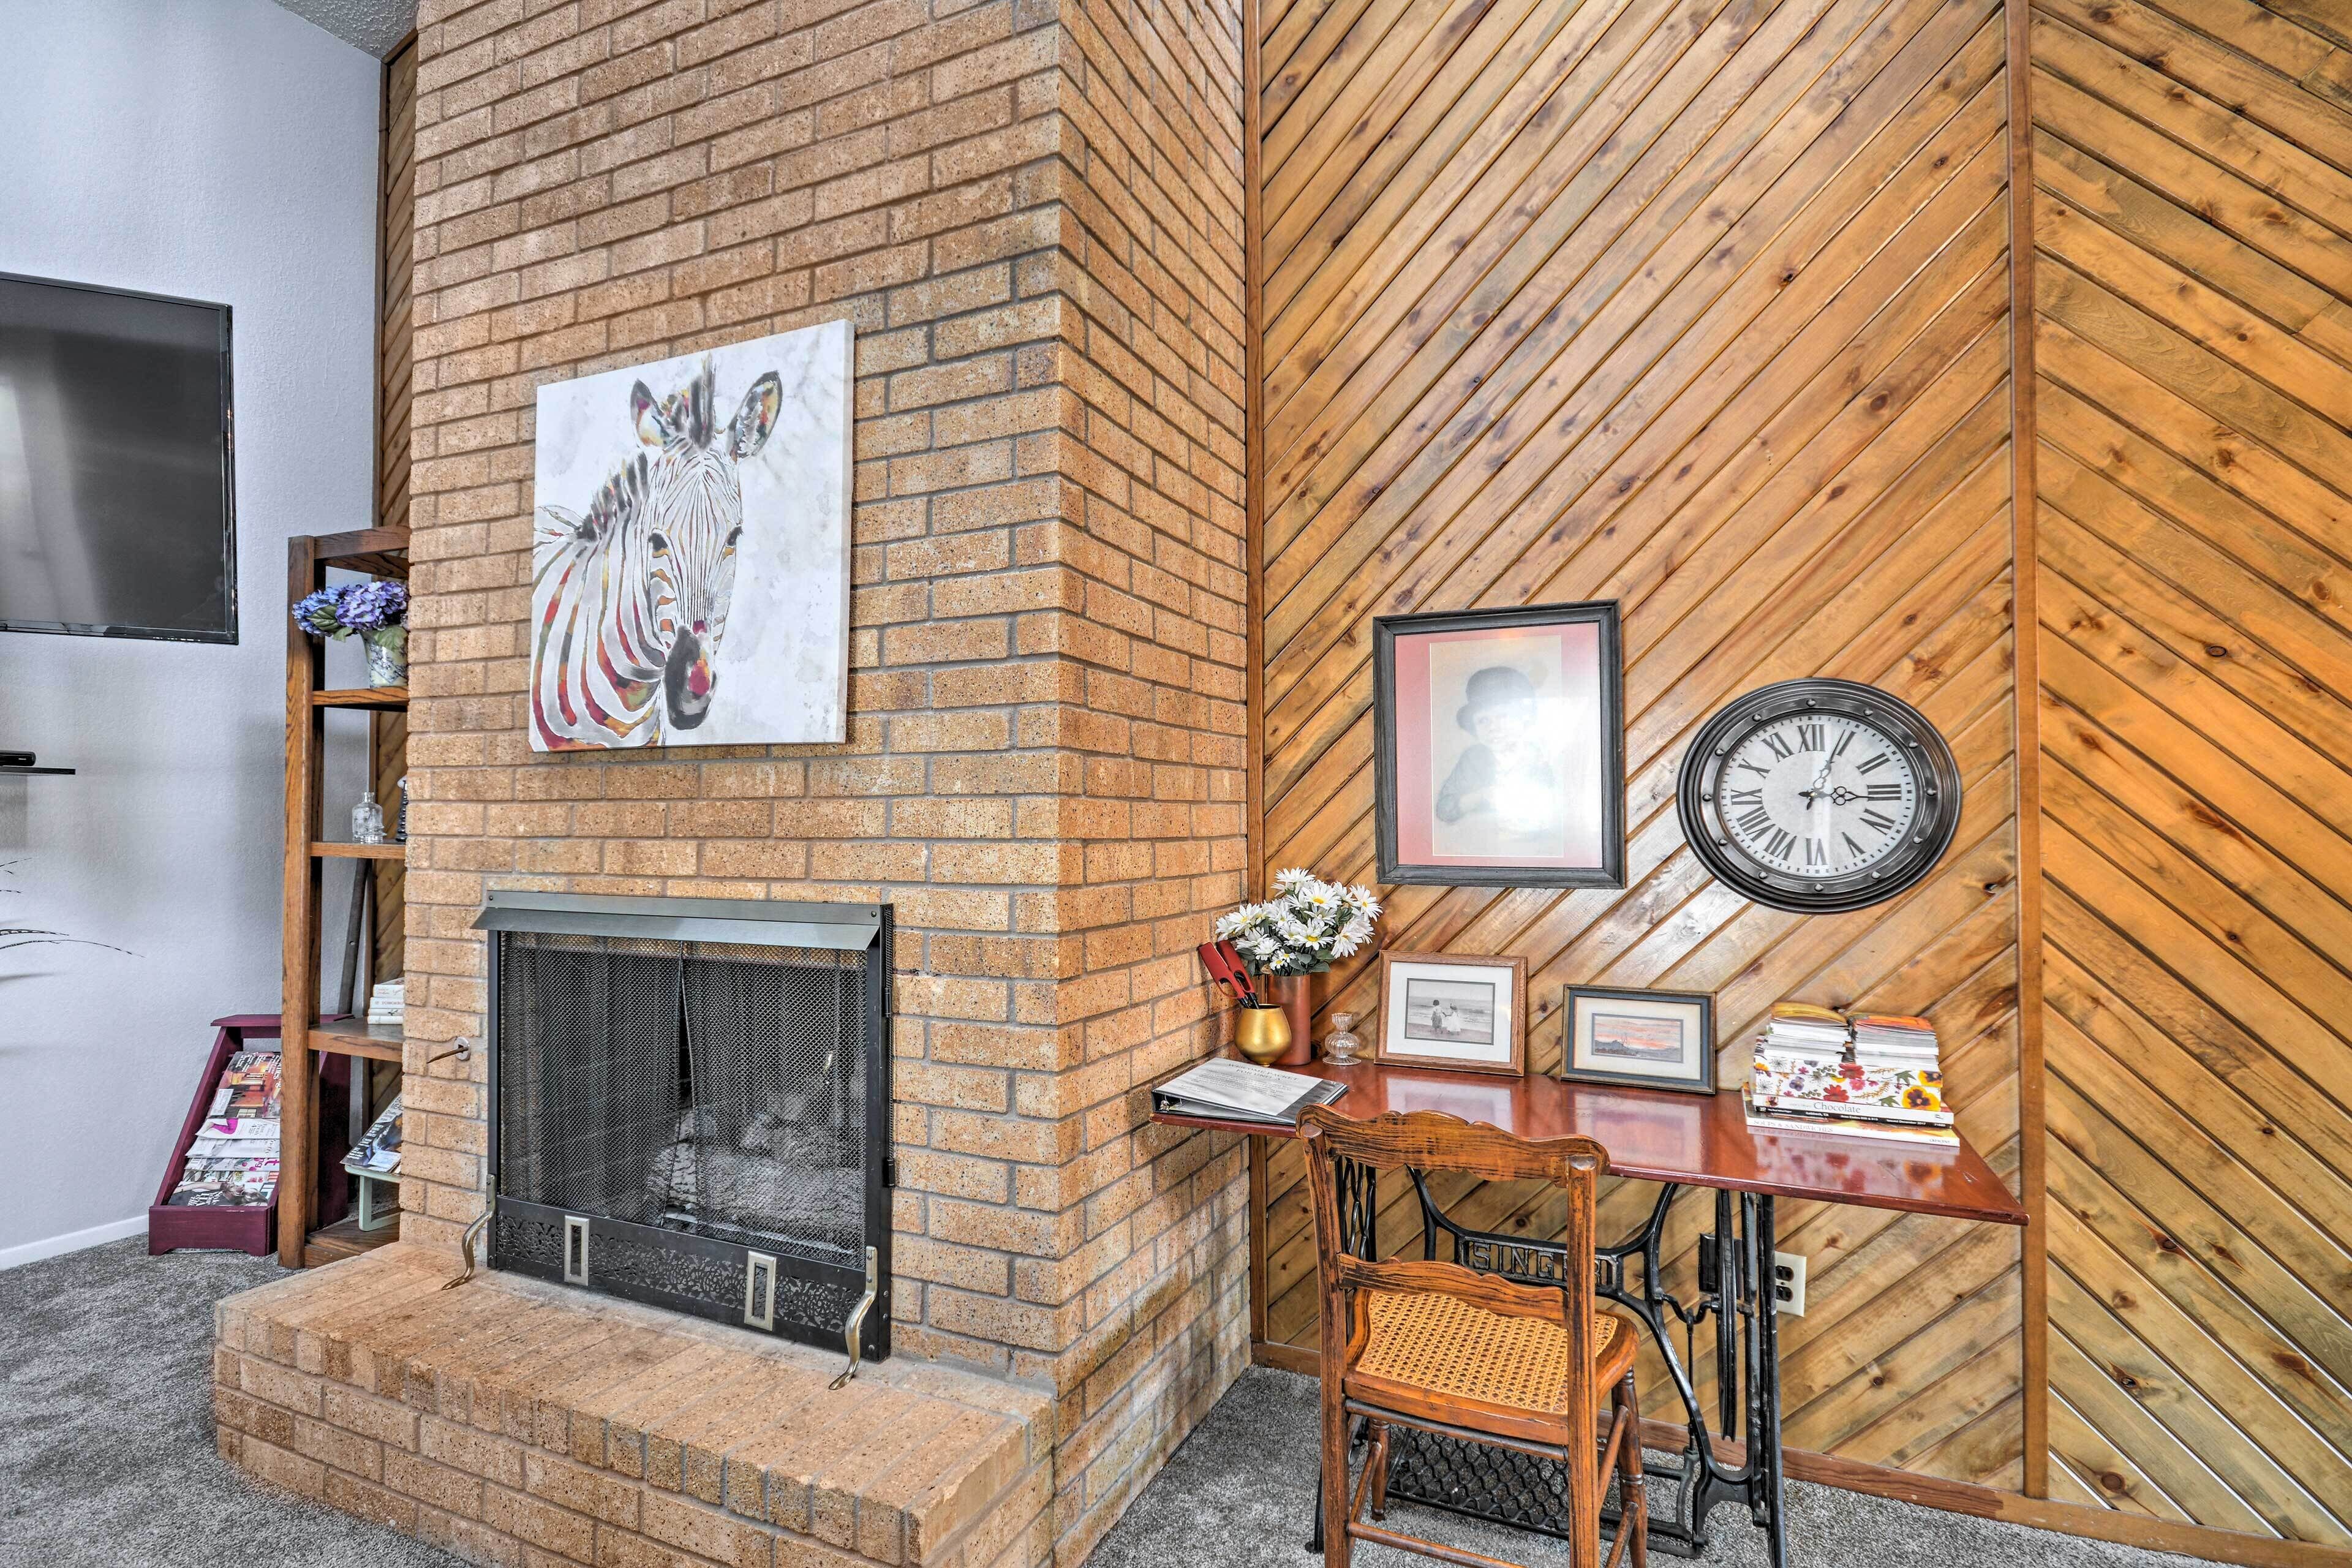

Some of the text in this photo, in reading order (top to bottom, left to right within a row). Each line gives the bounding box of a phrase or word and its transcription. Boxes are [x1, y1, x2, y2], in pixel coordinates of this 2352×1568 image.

[1761, 732, 1795, 763] XI
[1798, 724, 1825, 752] XII
[1738, 759, 1771, 778] X
[1857, 753, 1892, 776] II
[1731, 788, 1763, 805] IX
[1866, 784, 1902, 801] III
[1736, 806, 1776, 842] VIII
[1860, 809, 1896, 835] IV
[1763, 828, 1797, 861] VII
[1806, 838, 1828, 865] VI
[1841, 832, 1866, 858] V
[1814, 1102, 1861, 1114] Chocolate
[1784, 1123, 1833, 1133] SANDWICHES
[1473, 1242, 1601, 1286] SING
